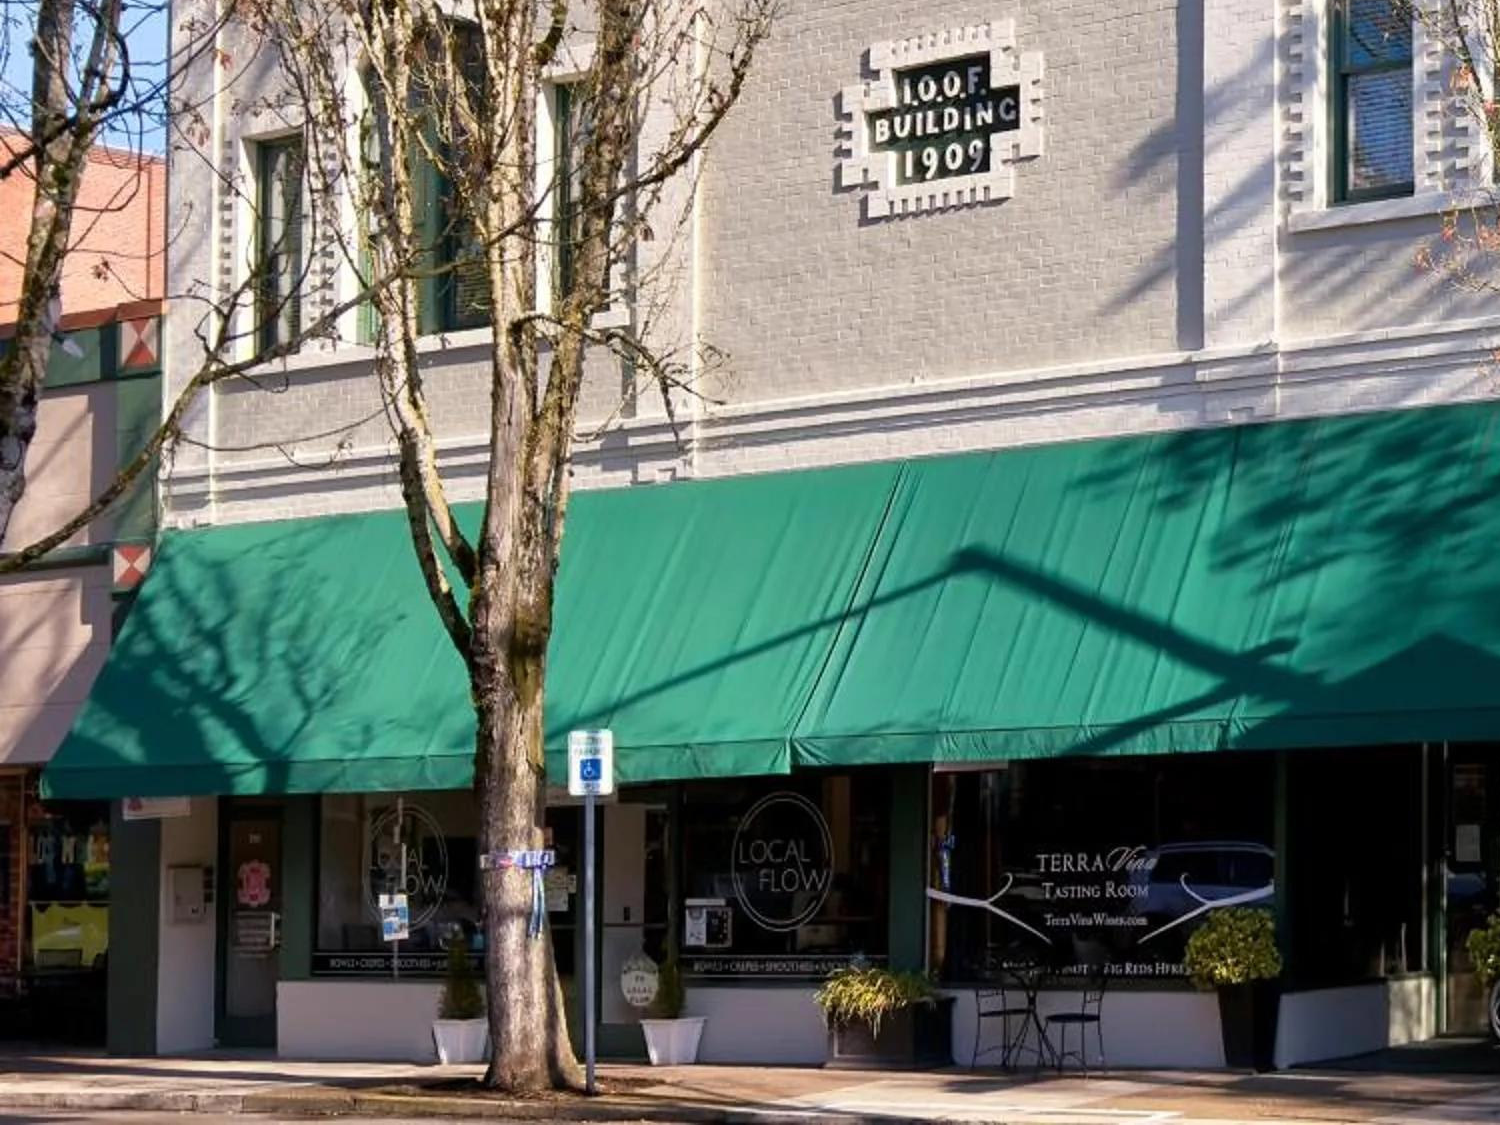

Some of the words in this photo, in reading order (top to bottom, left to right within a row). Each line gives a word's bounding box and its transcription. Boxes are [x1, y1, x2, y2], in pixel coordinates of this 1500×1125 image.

[903, 66, 987, 107] I.O.O.F.
[874, 97, 1017, 142] BUILDING
[904, 139, 984, 179] 1909
[739, 839, 811, 864] LOCAL
[1036, 853, 1104, 872] TERRA
[1105, 844, 1158, 872] Vina
[759, 868, 827, 892] FLOW
[1042, 882, 1101, 898] TASTING
[1105, 881, 1149, 897] ROOM
